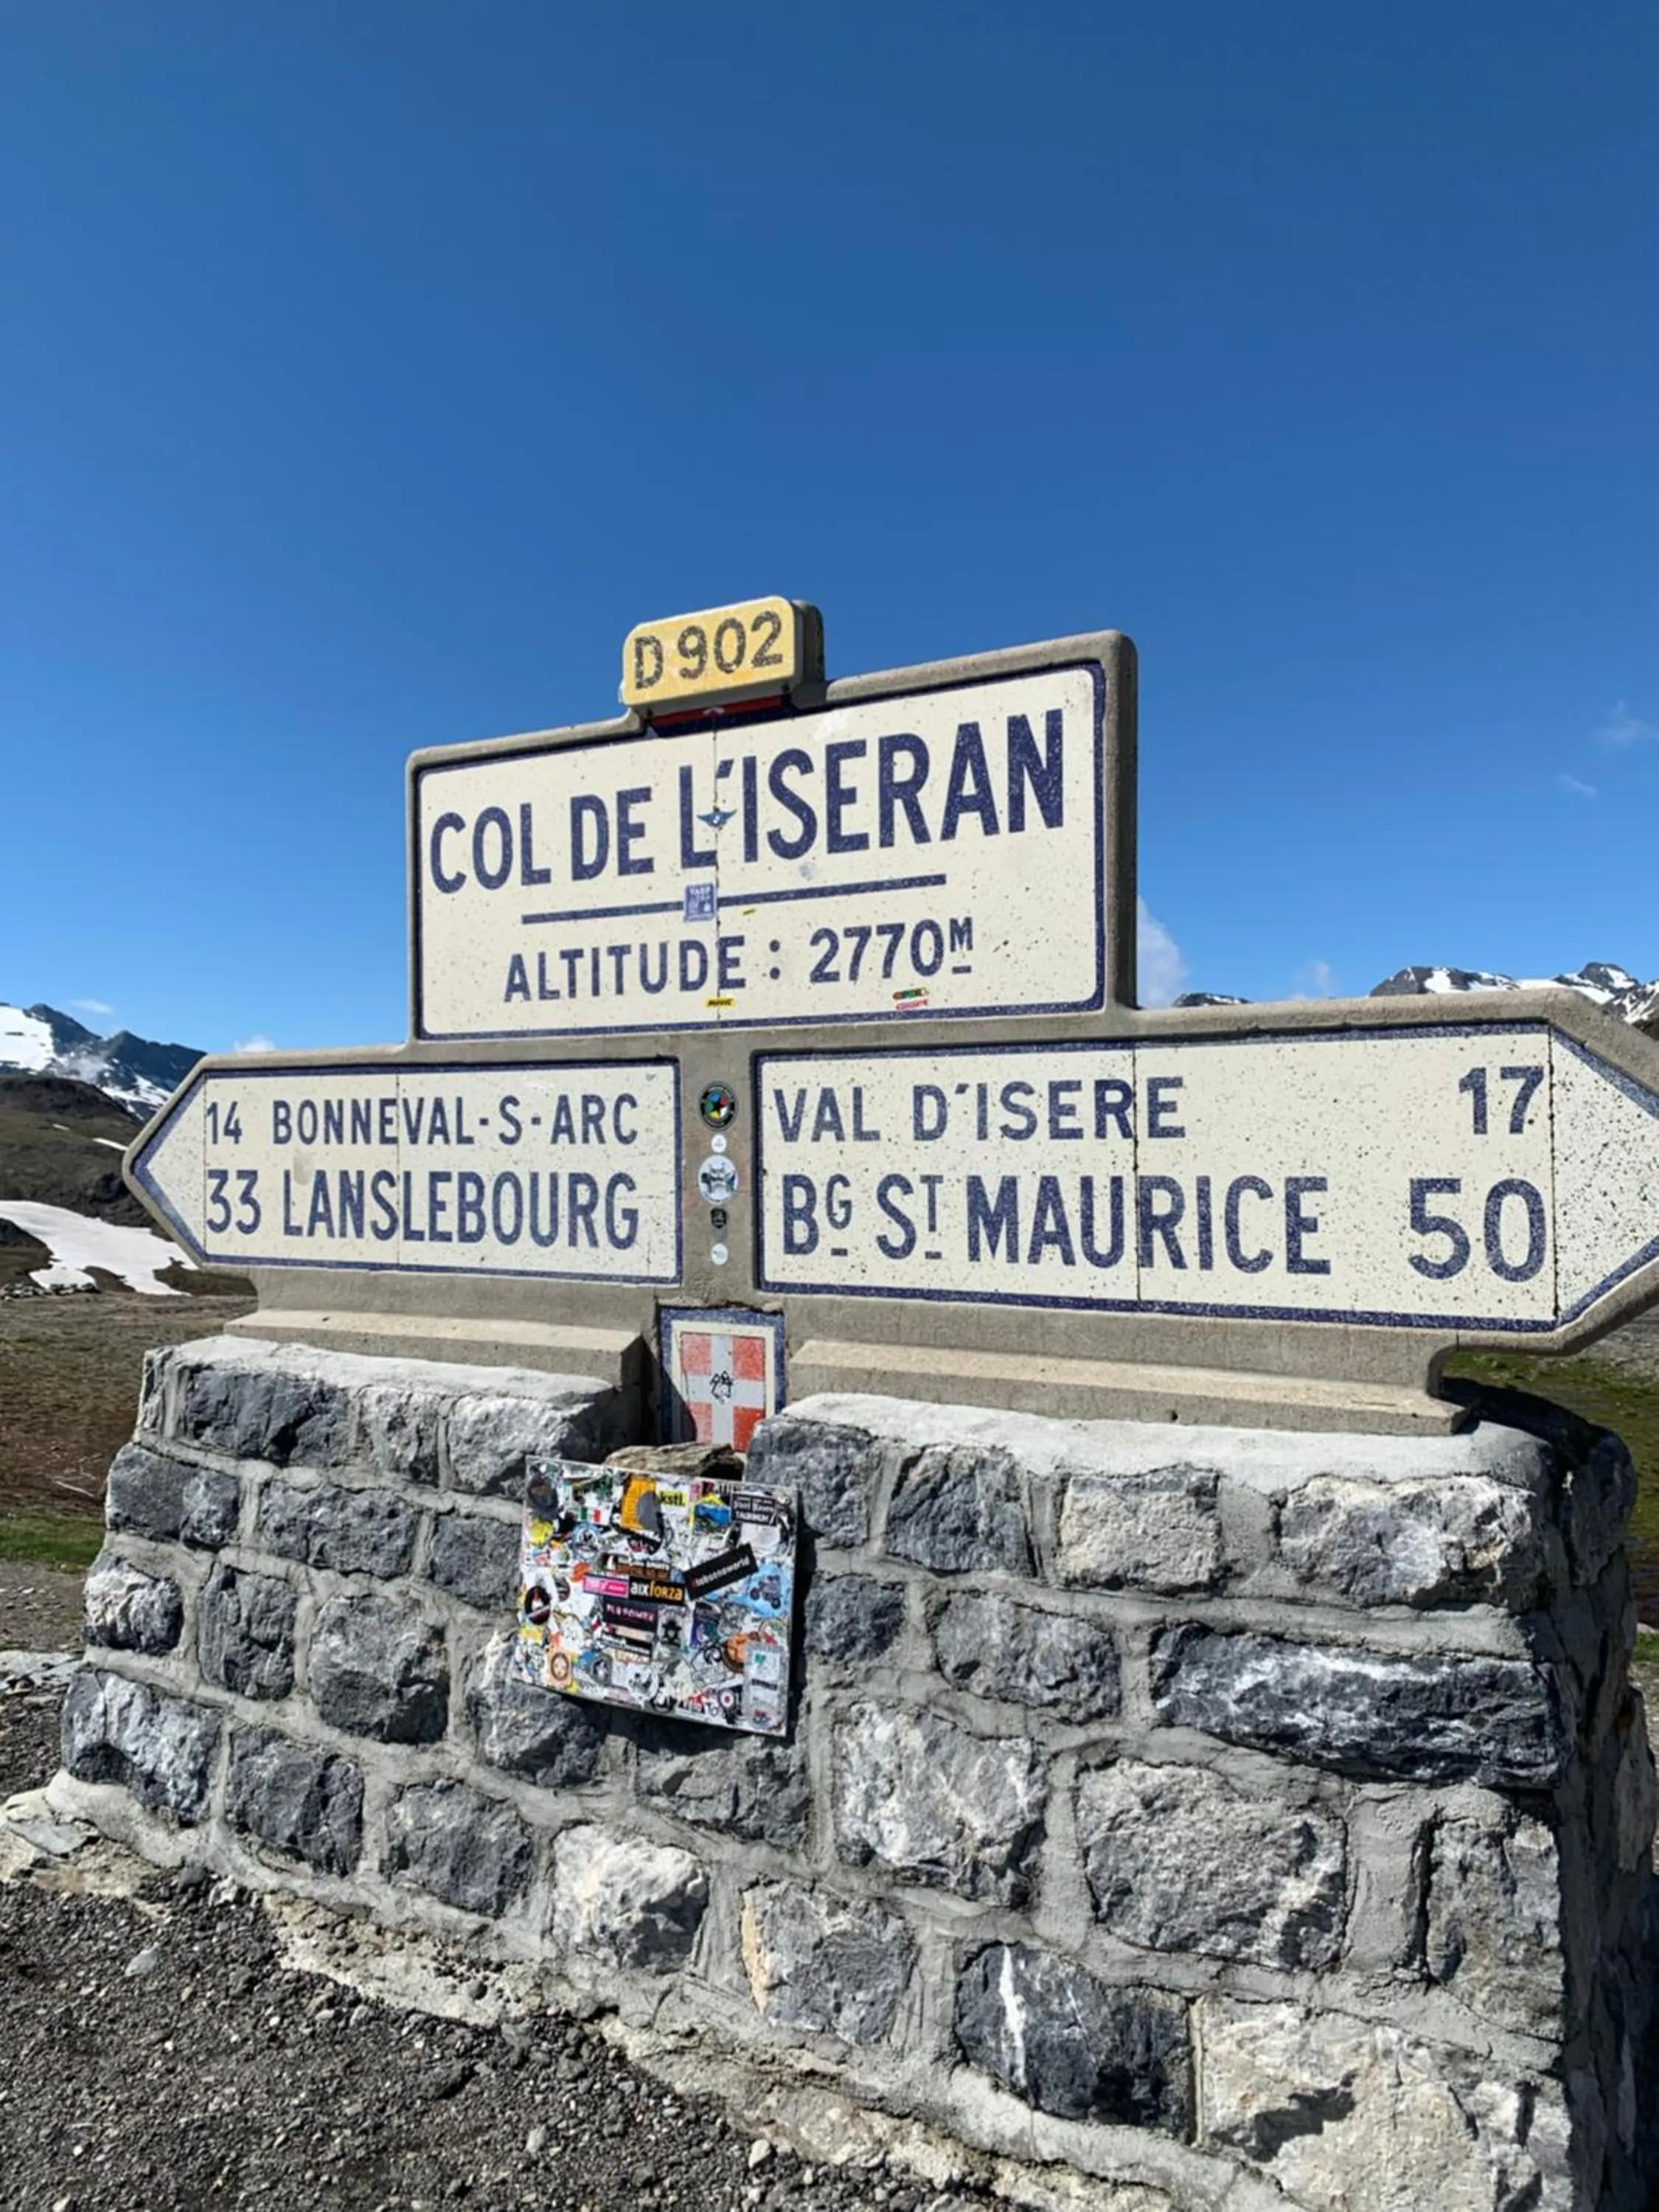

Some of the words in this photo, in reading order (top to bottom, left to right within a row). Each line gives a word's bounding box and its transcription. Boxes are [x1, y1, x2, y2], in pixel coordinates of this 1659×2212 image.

[633, 634, 664, 689] D
[677, 610, 785, 681] 902
[431, 804, 551, 894] COL
[571, 787, 654, 880] DE
[678, 708, 1064, 871] L'ISERAN
[206, 1102, 242, 1144] 14
[774, 1087, 880, 1142] VAL
[914, 1077, 1185, 1141] D'ISERE
[1459, 1066, 1543, 1134] 17
[206, 1169, 261, 1234] 33
[284, 1170, 638, 1249] LANSLEBOURG
[967, 1172, 1330, 1274] MAURICE
[1408, 1178, 1545, 1282] 50
